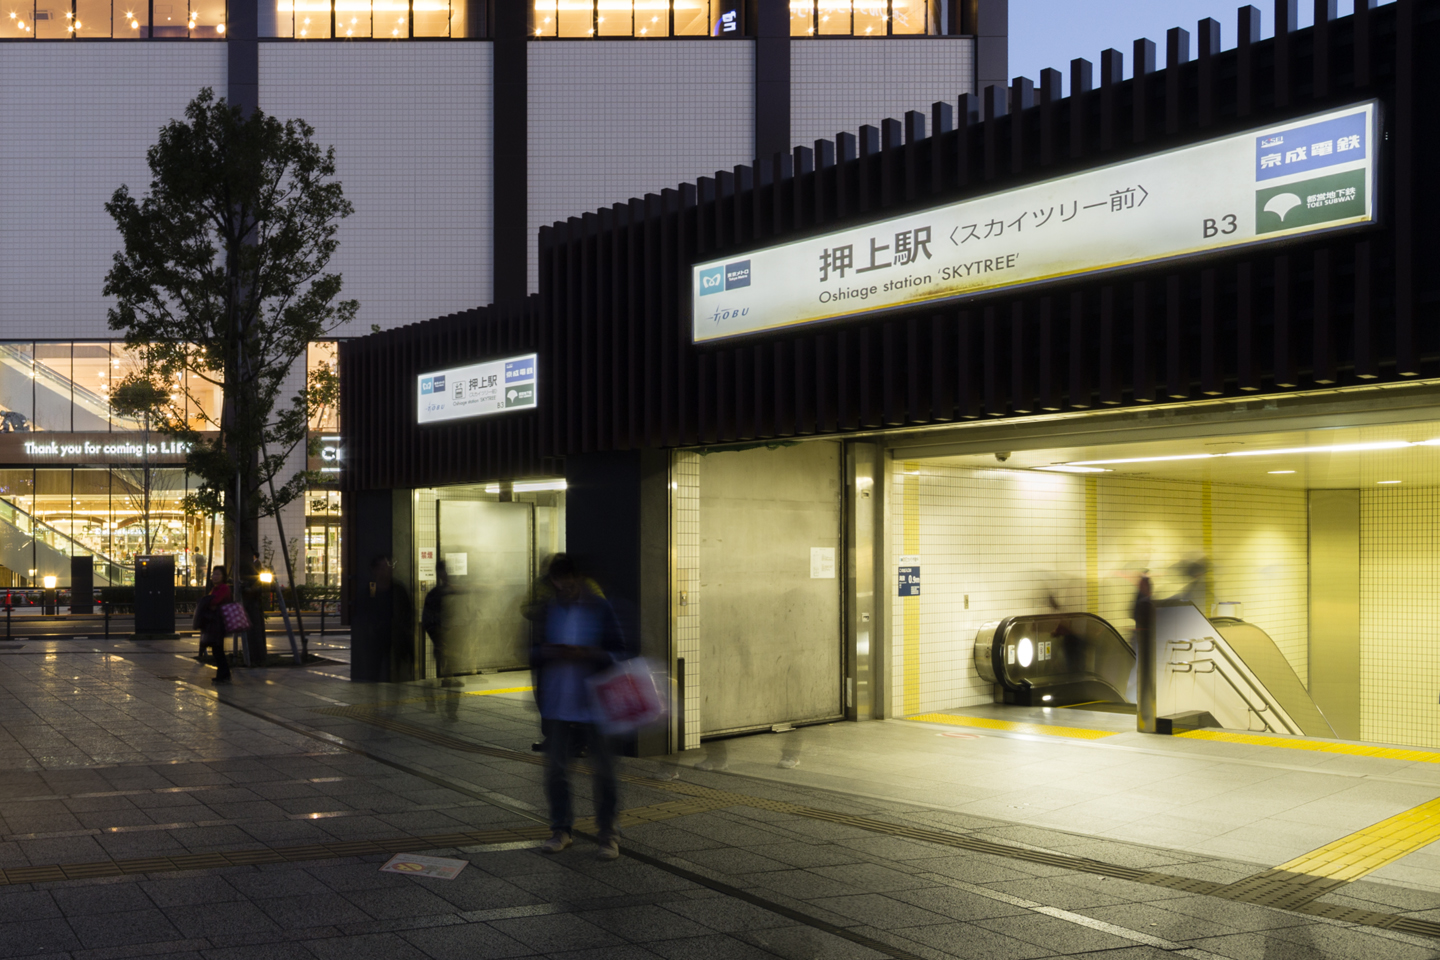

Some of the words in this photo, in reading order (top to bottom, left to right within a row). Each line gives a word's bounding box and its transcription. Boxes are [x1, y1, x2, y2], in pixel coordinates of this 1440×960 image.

[1261, 134, 1360, 170] 京成電鉄
[1307, 200, 1323, 209] TOEI
[1324, 194, 1356, 206] SUBWAY
[1202, 213, 1238, 239] B3
[819, 225, 933, 283] 押上駅
[819, 284, 878, 304] Oshiage
[883, 274, 932, 292] station
[712, 307, 750, 322] TOBU
[468, 375, 498, 391] 押上駅
[24, 441, 59, 454] Thank
[60, 445, 82, 457] you
[84, 441, 101, 454] for
[103, 442, 143, 457] coming
[146, 442, 158, 454] to
